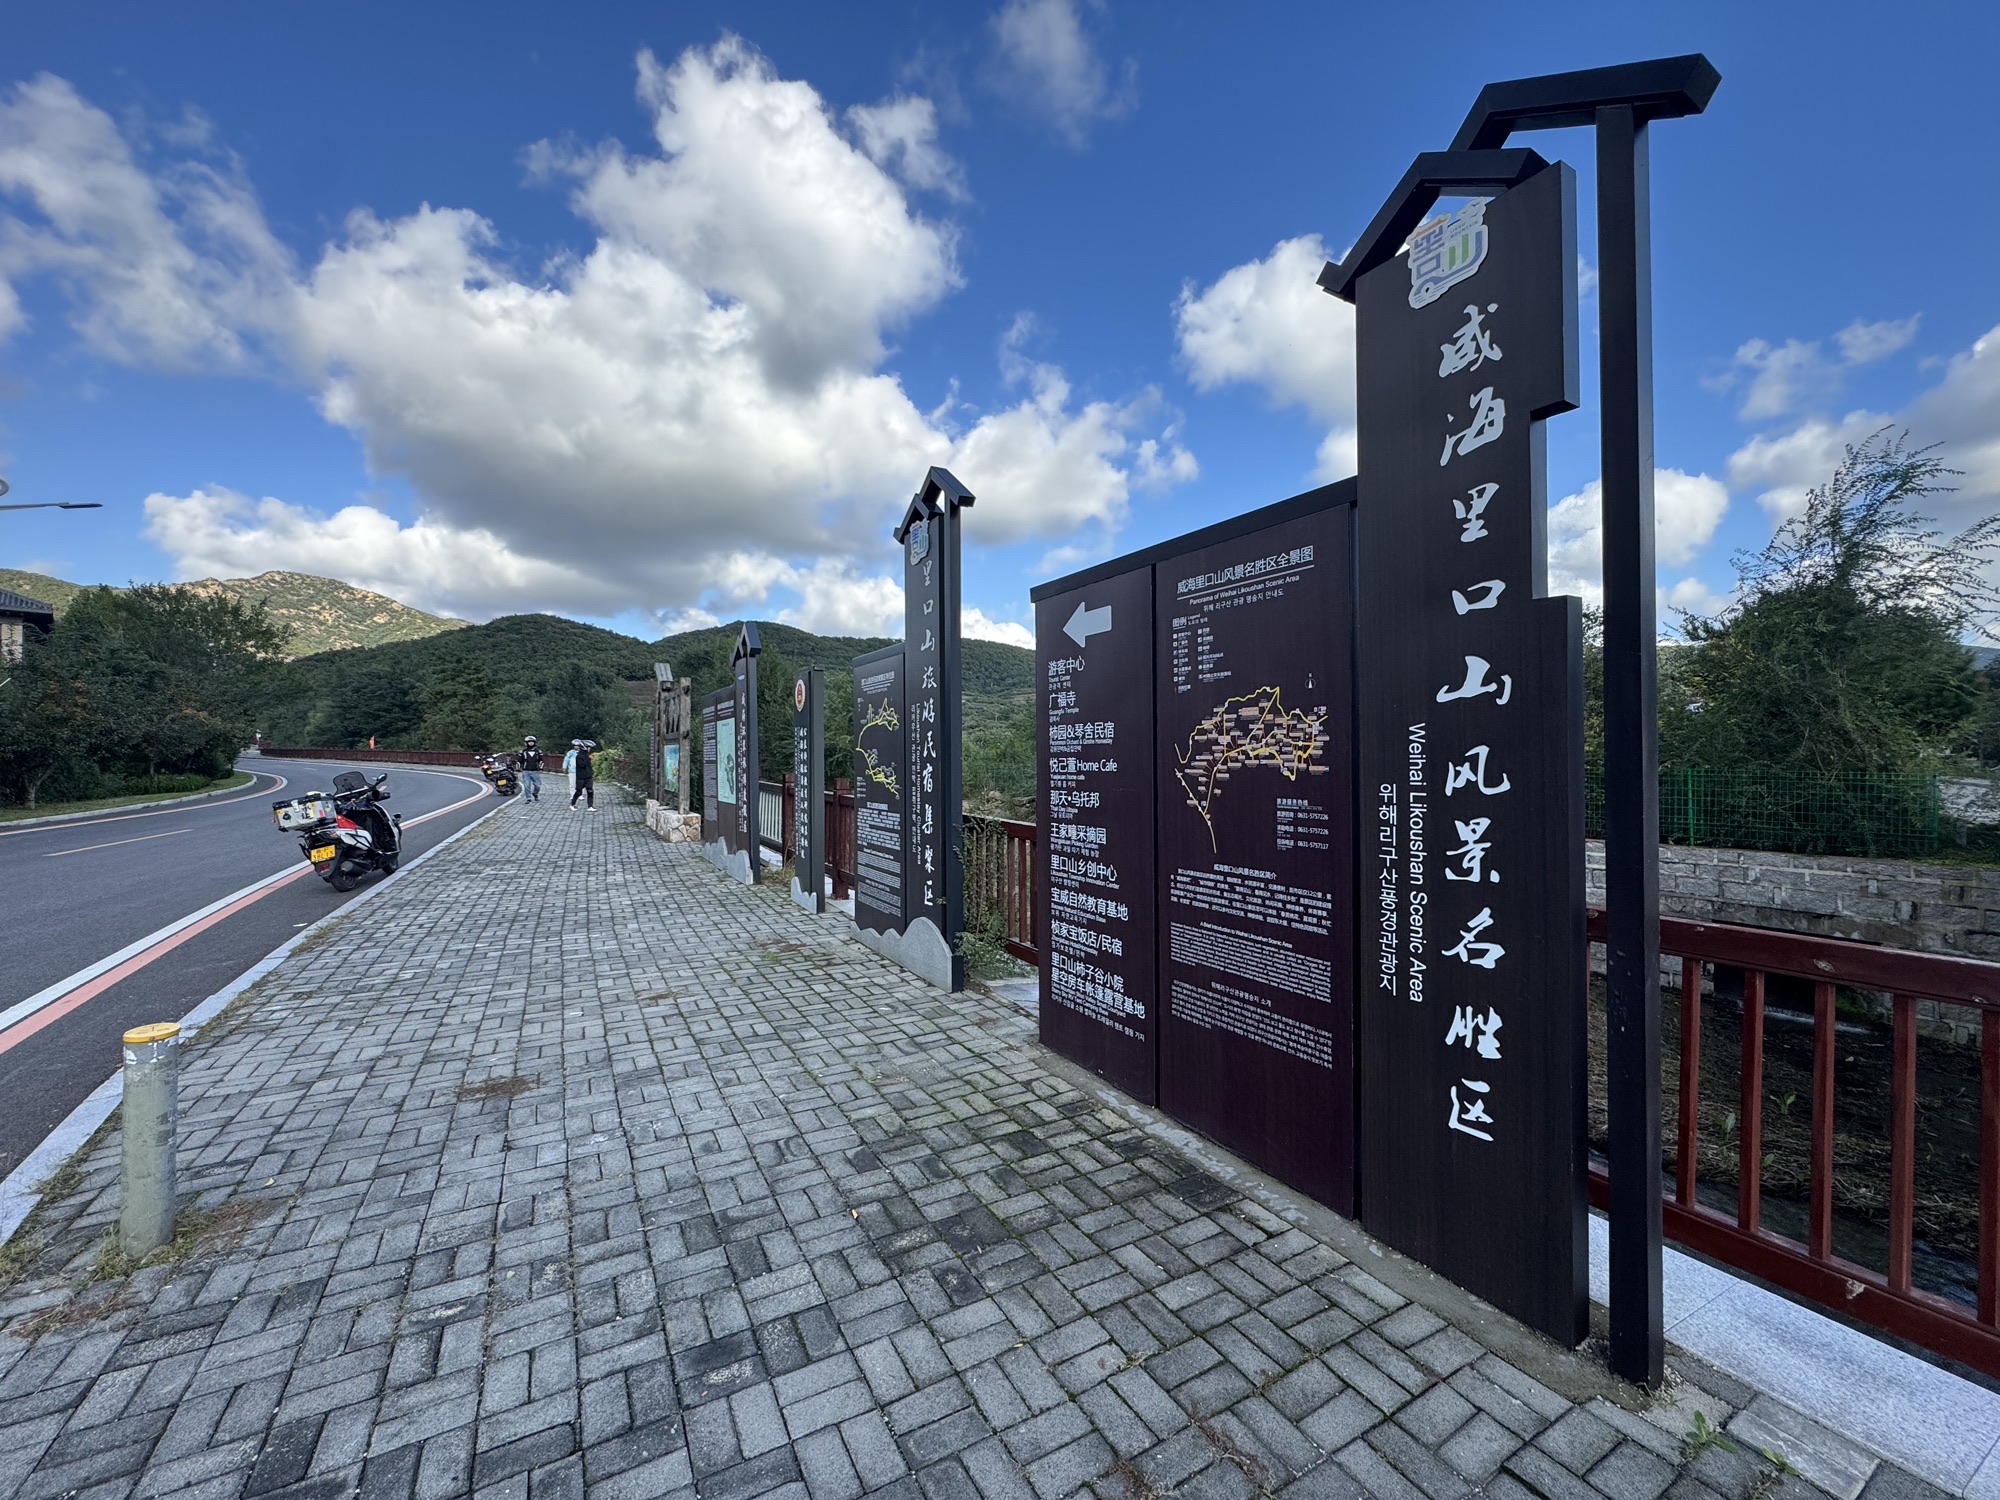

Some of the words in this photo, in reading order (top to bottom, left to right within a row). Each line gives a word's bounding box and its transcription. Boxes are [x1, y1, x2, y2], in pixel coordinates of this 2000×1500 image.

[1177, 545, 1314, 594] 威海里口山风景名胜区全景图
[1189, 595, 1213, 606] Panorama
[1219, 589, 1237, 599] Weihai
[1237, 583, 1264, 594] Likoushan
[1265, 578, 1285, 588] Scenic
[1285, 575, 1300, 584] Area
[1048, 655, 1085, 676] 游客中心
[1049, 690, 1076, 708] 广福寺
[1100, 758, 1118, 771] Cafe
[1409, 722, 1426, 785] Weihai
[1410, 792, 1427, 885] Likoushan
[1051, 854, 1117, 881] 里口山乡创中心
[1051, 887, 1128, 921] 宝威自然教育基地
[1410, 891, 1428, 954] Scenic
[1051, 951, 1124, 992] 里口山柿子谷小院
[1409, 957, 1427, 1003] Area
[1051, 967, 1145, 1019] 星空房车帐篷露营基地
